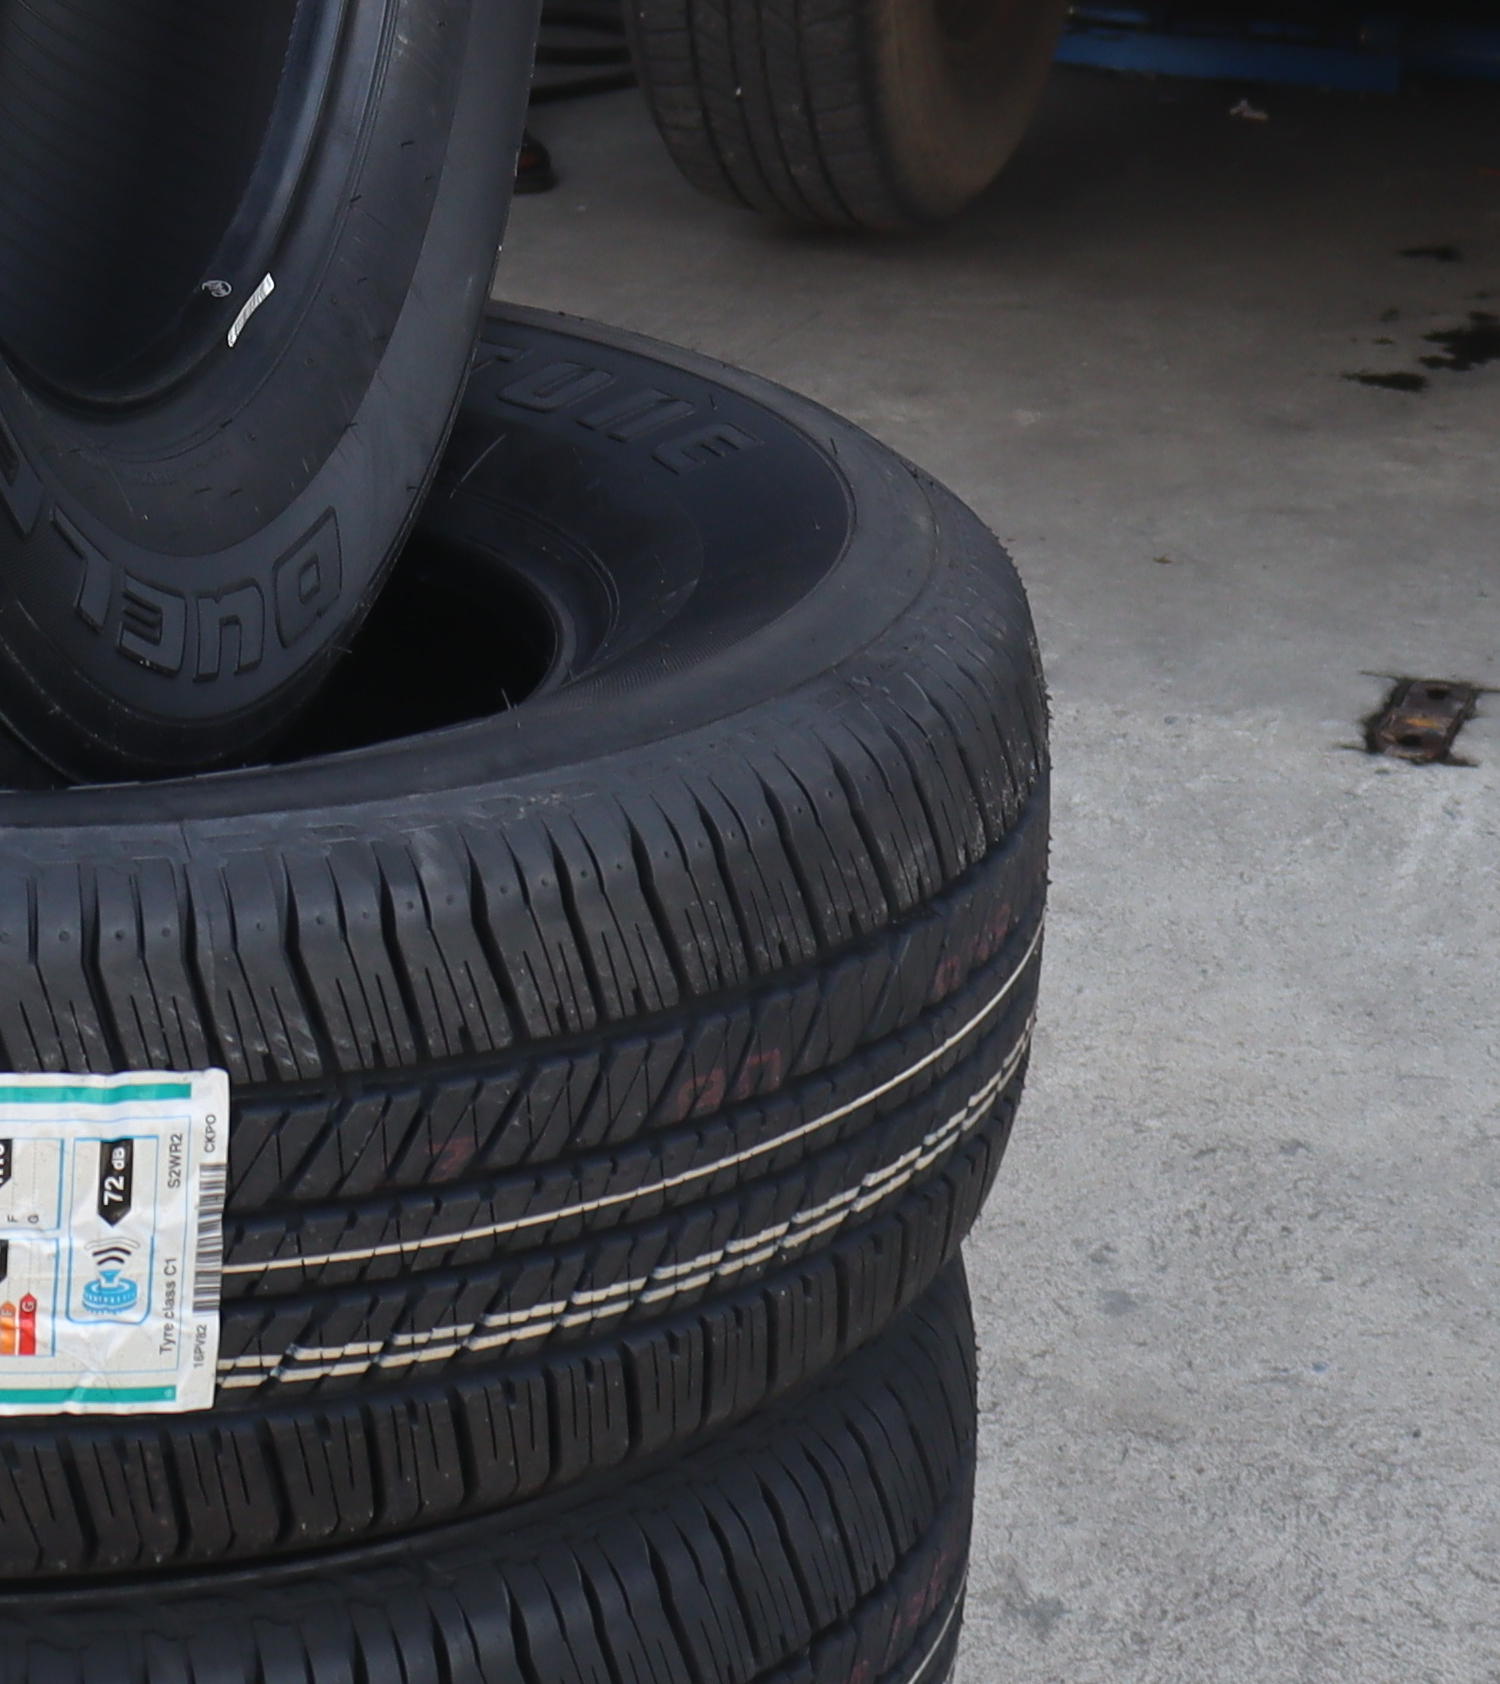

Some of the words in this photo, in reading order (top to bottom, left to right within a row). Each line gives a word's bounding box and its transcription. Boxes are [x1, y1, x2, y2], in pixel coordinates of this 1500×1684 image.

[204, 1114, 217, 1153] CKPO
[111, 1146, 126, 1170] dB
[168, 1133, 183, 1189] S2WR2
[103, 1176, 125, 1206] 72
[164, 1258, 177, 1276] C1
[163, 1279, 177, 1320] class
[159, 1321, 177, 1355] Tyre
